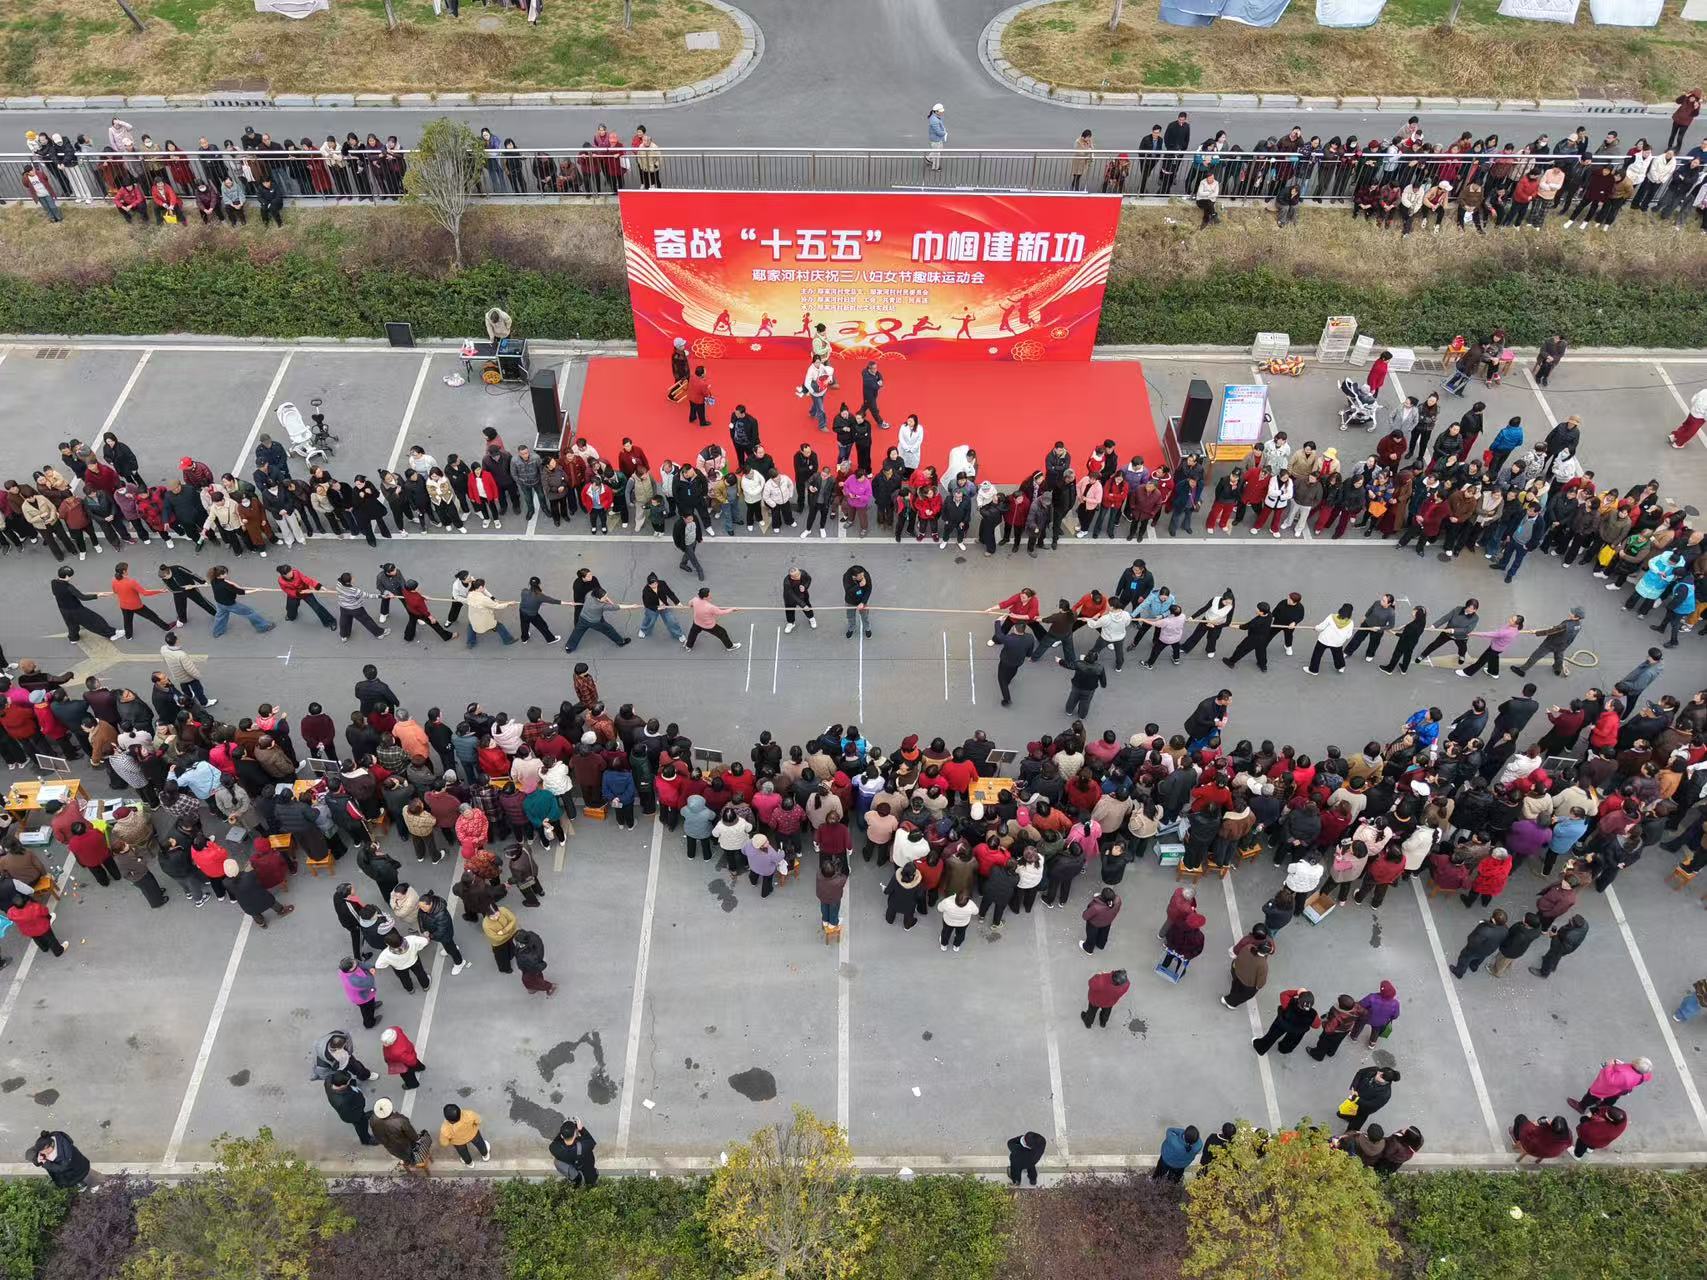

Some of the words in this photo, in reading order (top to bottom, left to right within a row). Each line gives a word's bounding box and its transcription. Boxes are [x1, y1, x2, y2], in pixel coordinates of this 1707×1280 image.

[911, 231, 1086, 263] 巾帼建新功
